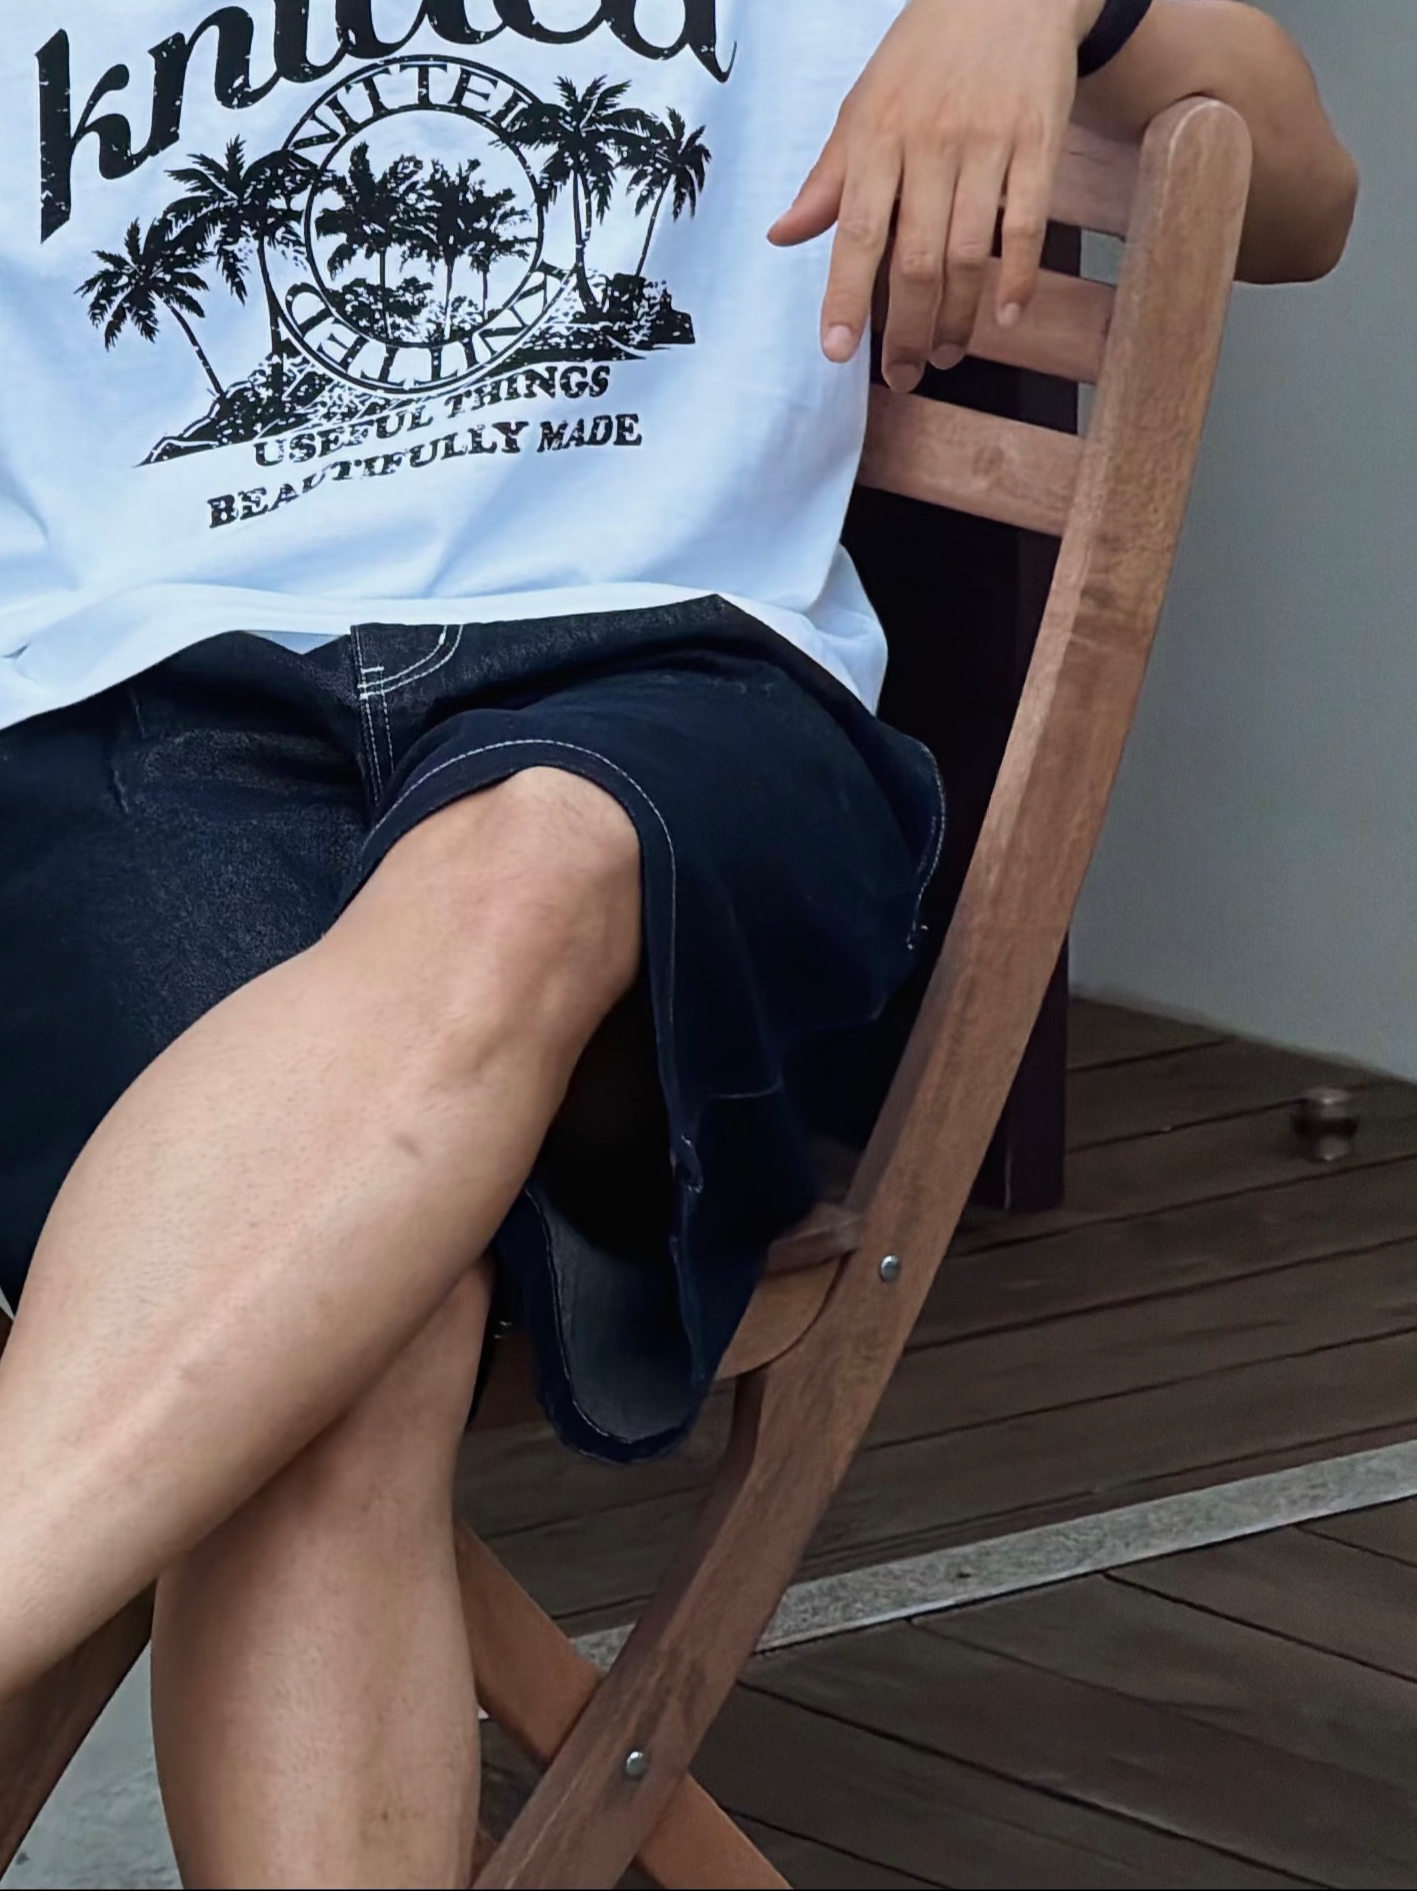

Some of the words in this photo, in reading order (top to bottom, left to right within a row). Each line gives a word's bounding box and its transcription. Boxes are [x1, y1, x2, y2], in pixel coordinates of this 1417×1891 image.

[253, 400, 433, 467] USEFUL
[444, 364, 611, 420] THINGS
[536, 413, 643, 454] MADE
